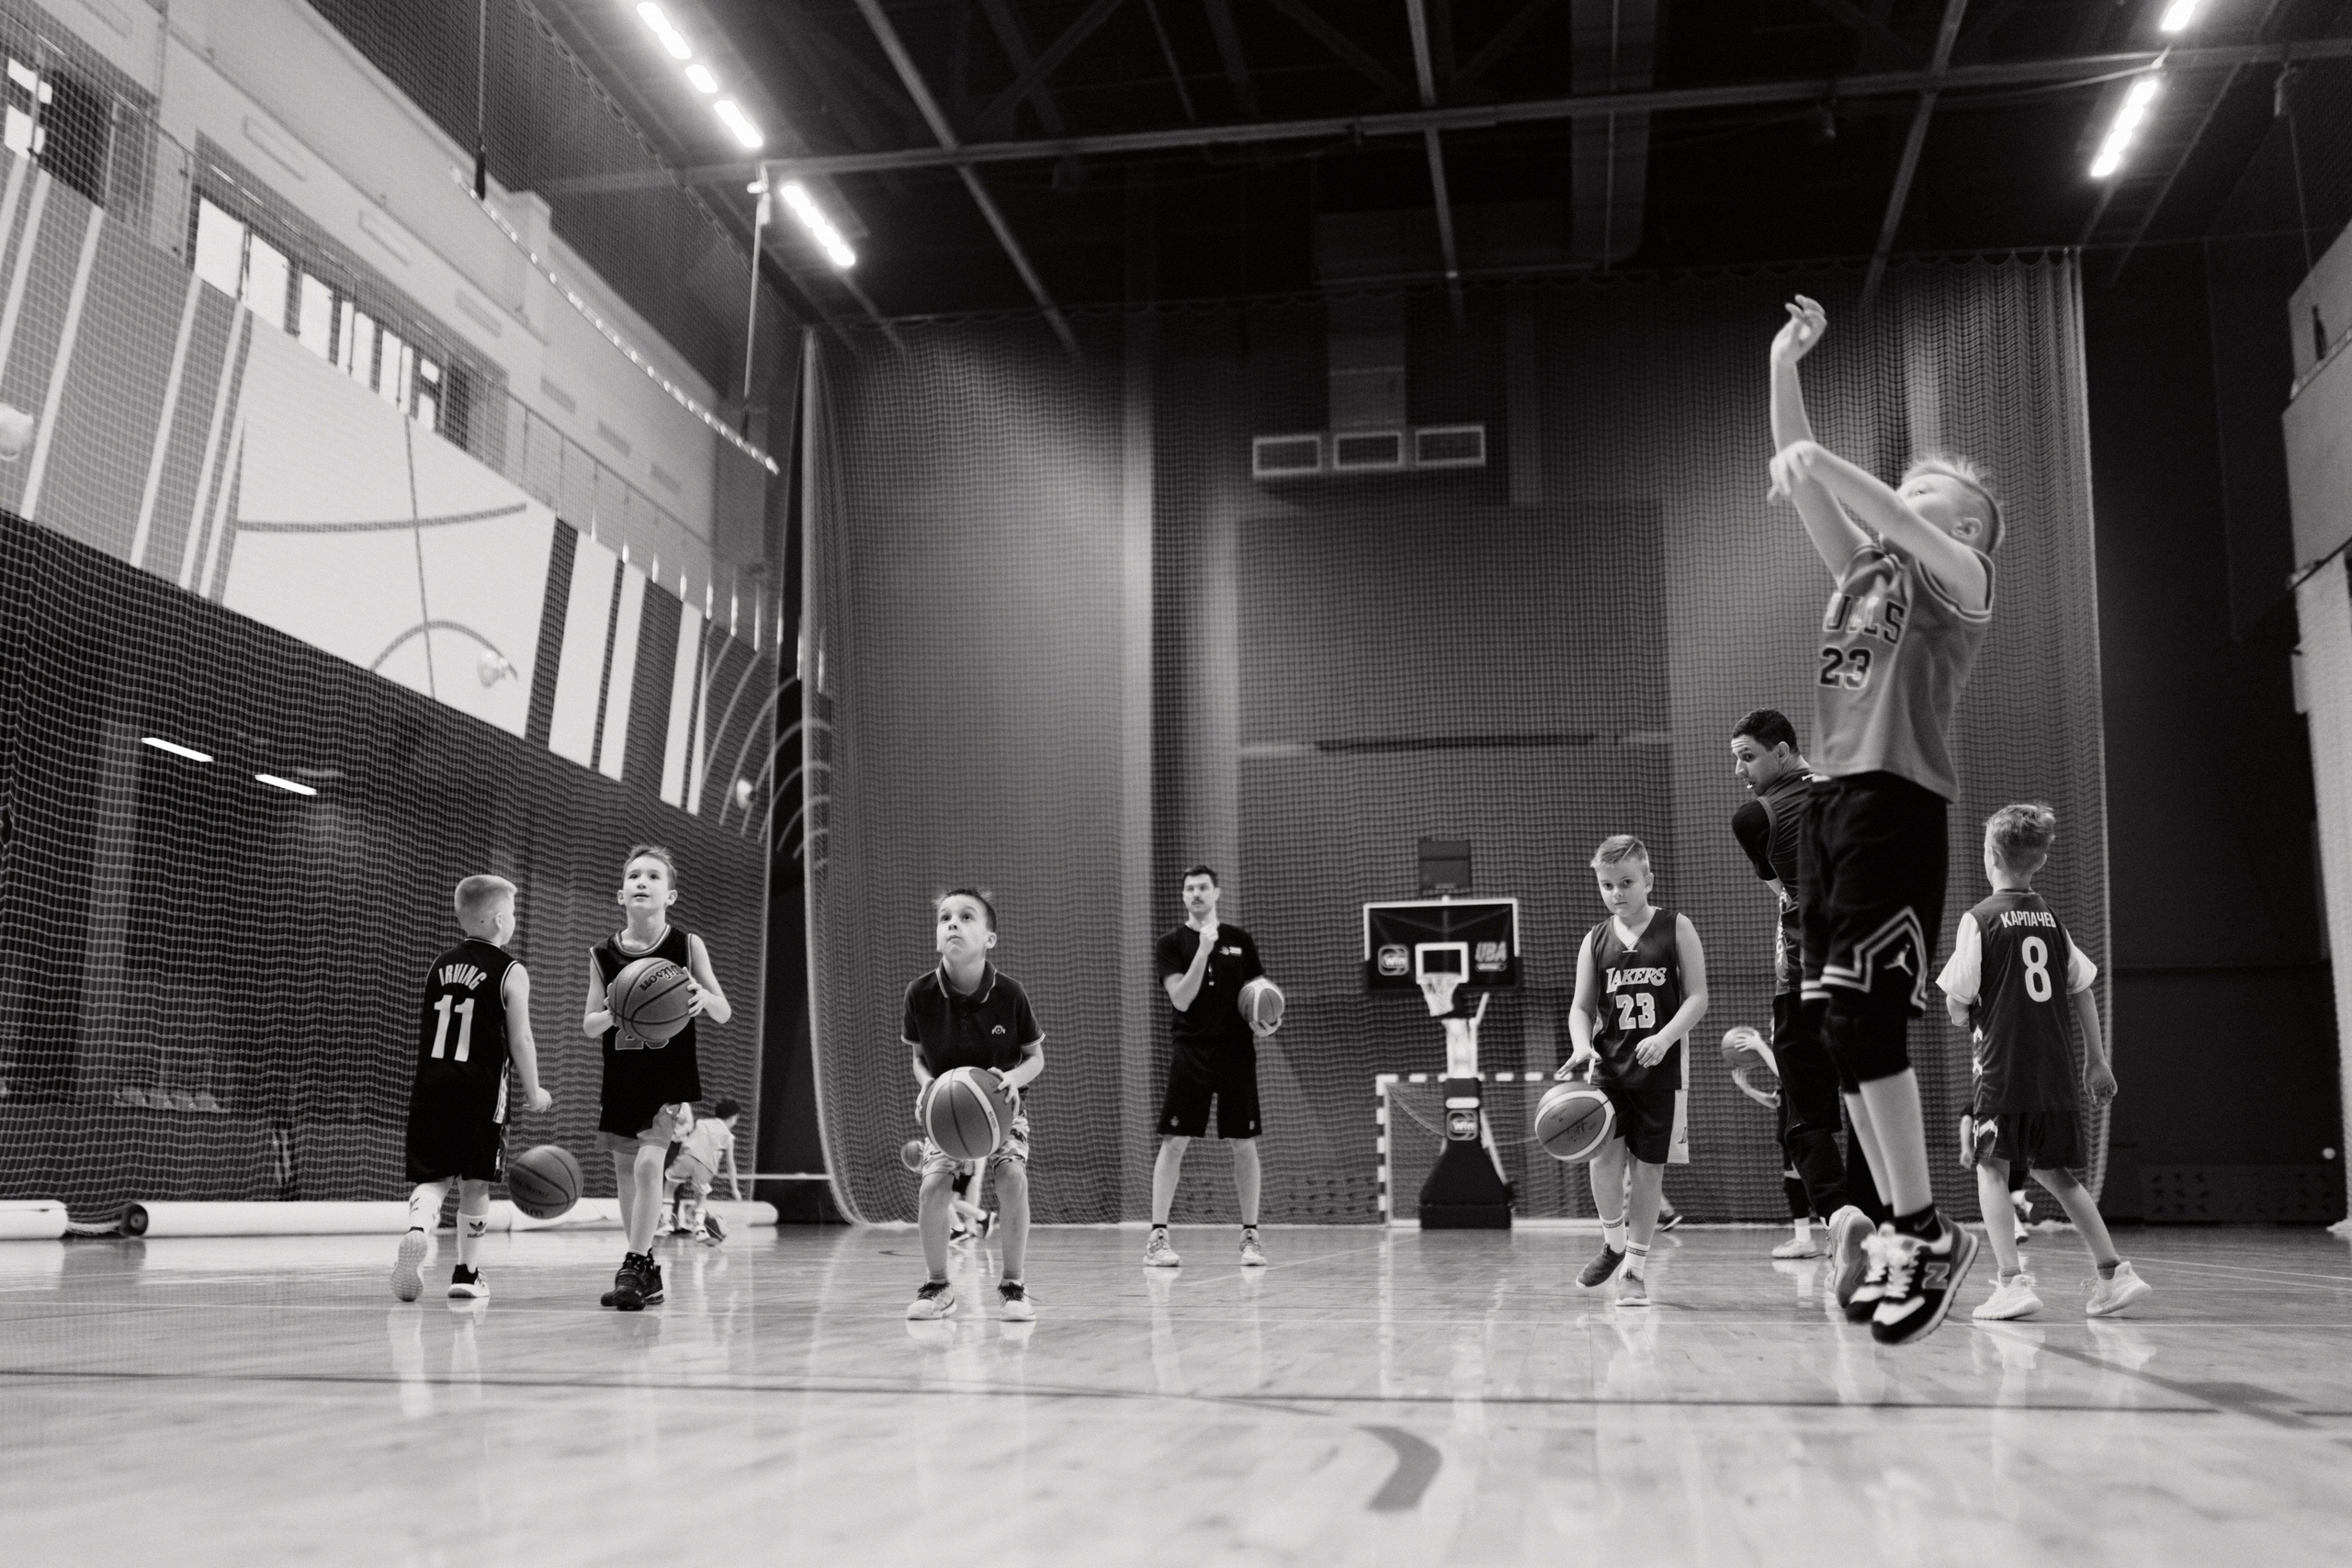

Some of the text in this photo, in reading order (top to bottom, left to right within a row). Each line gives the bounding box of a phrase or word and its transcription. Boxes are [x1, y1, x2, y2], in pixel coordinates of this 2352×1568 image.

[1819, 645, 1873, 689] 23
[2000, 910, 2057, 928] КАРПАЧЕВ
[438, 964, 487, 990] IRVING
[1606, 967, 1667, 994] LAKERS
[2022, 936, 2052, 1002] 8
[431, 994, 475, 1062] 11
[1615, 992, 1656, 1030] 23
